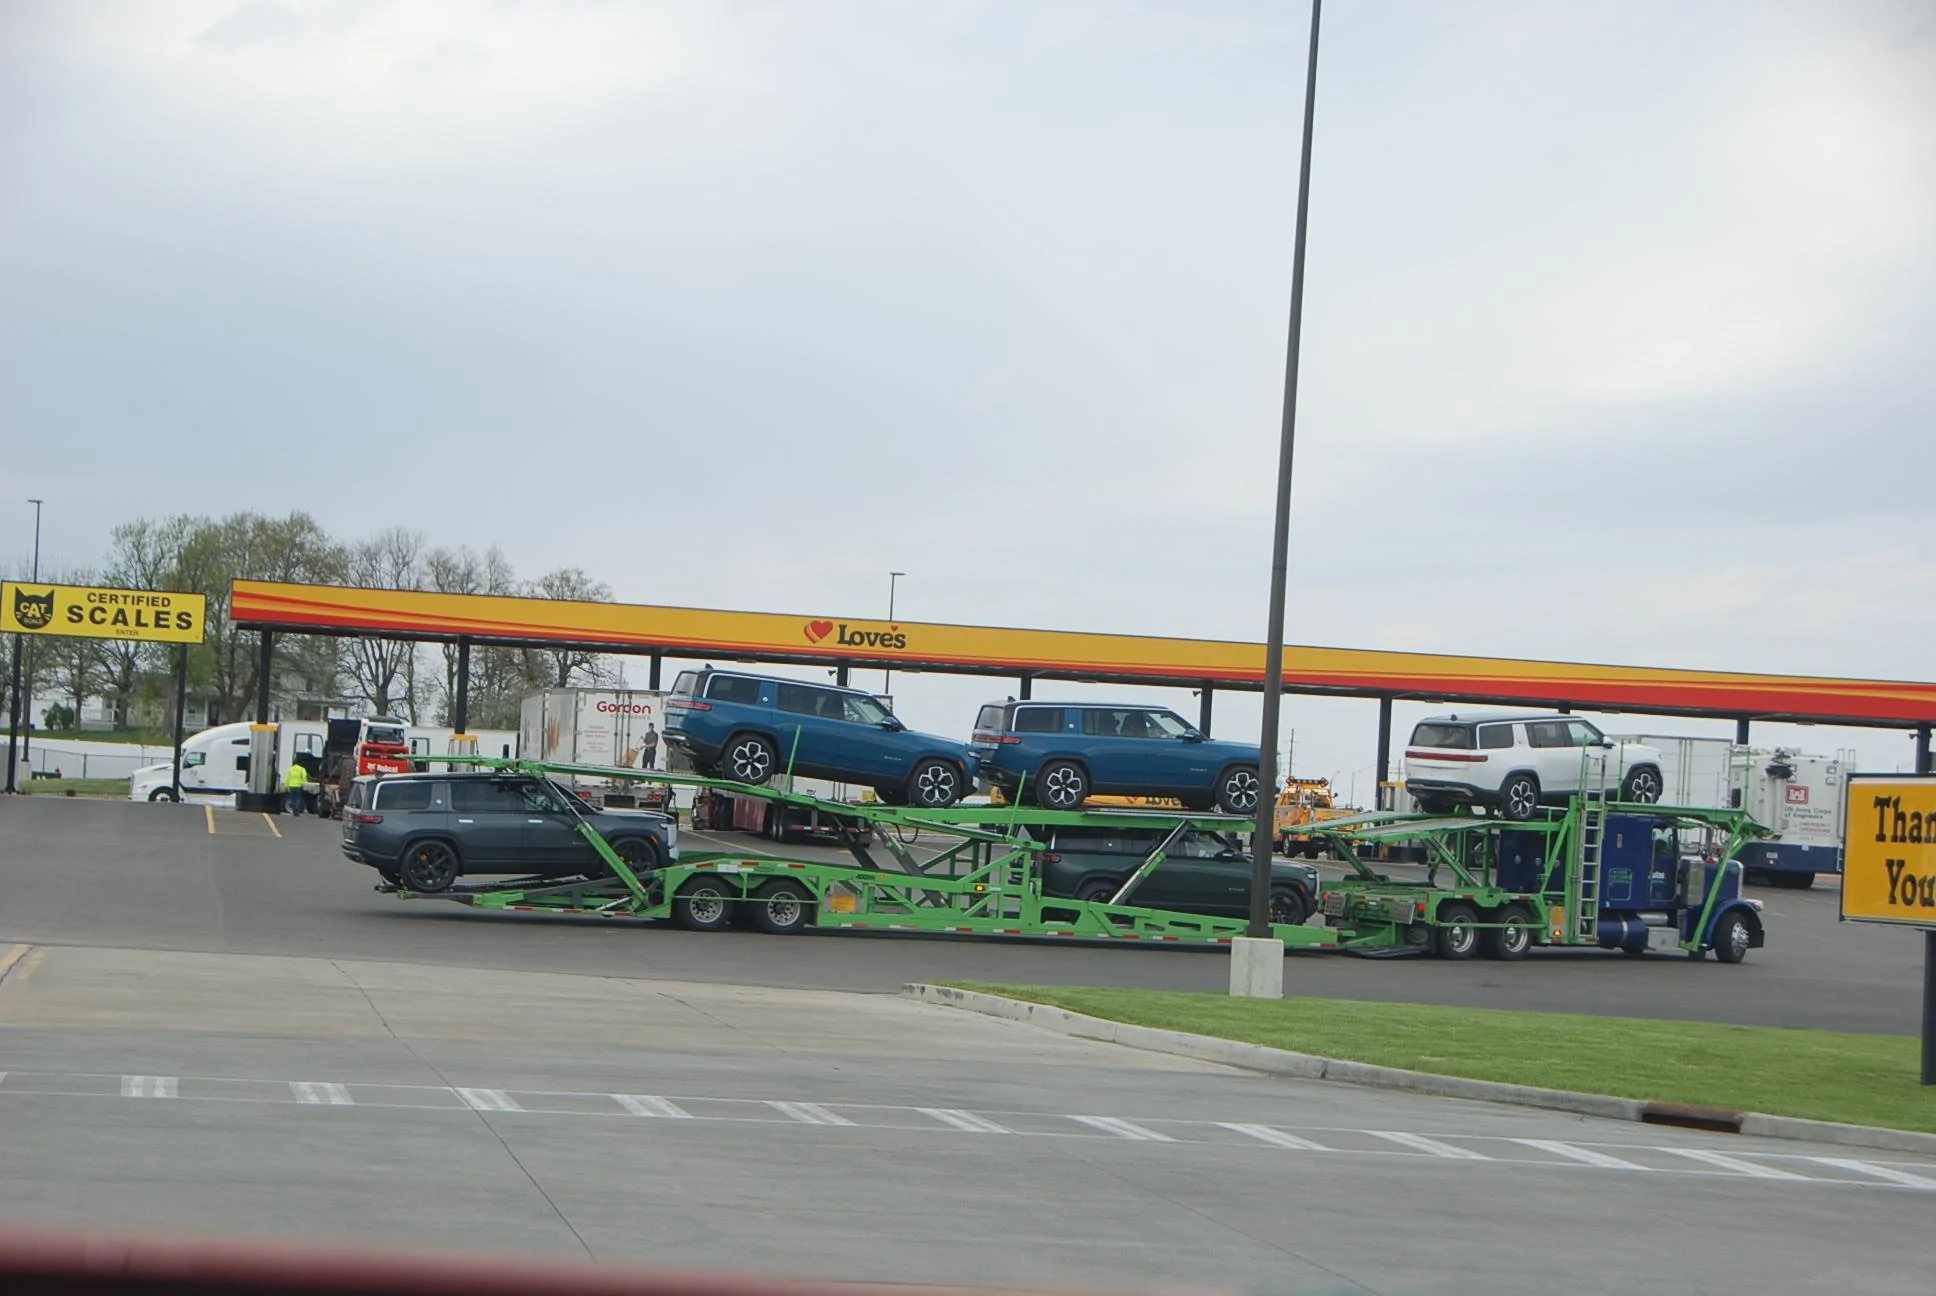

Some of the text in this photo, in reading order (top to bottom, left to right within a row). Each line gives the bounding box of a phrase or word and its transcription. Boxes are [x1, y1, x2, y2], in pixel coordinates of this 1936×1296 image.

[87, 592, 171, 607] CERTIFIED
[20, 602, 48, 618] CAT
[67, 604, 192, 630] SCALES
[23, 617, 43, 625] SCALE
[597, 701, 651, 714] Gordon
[1145, 796, 1181, 806] Love
[1885, 858, 1936, 908] You
